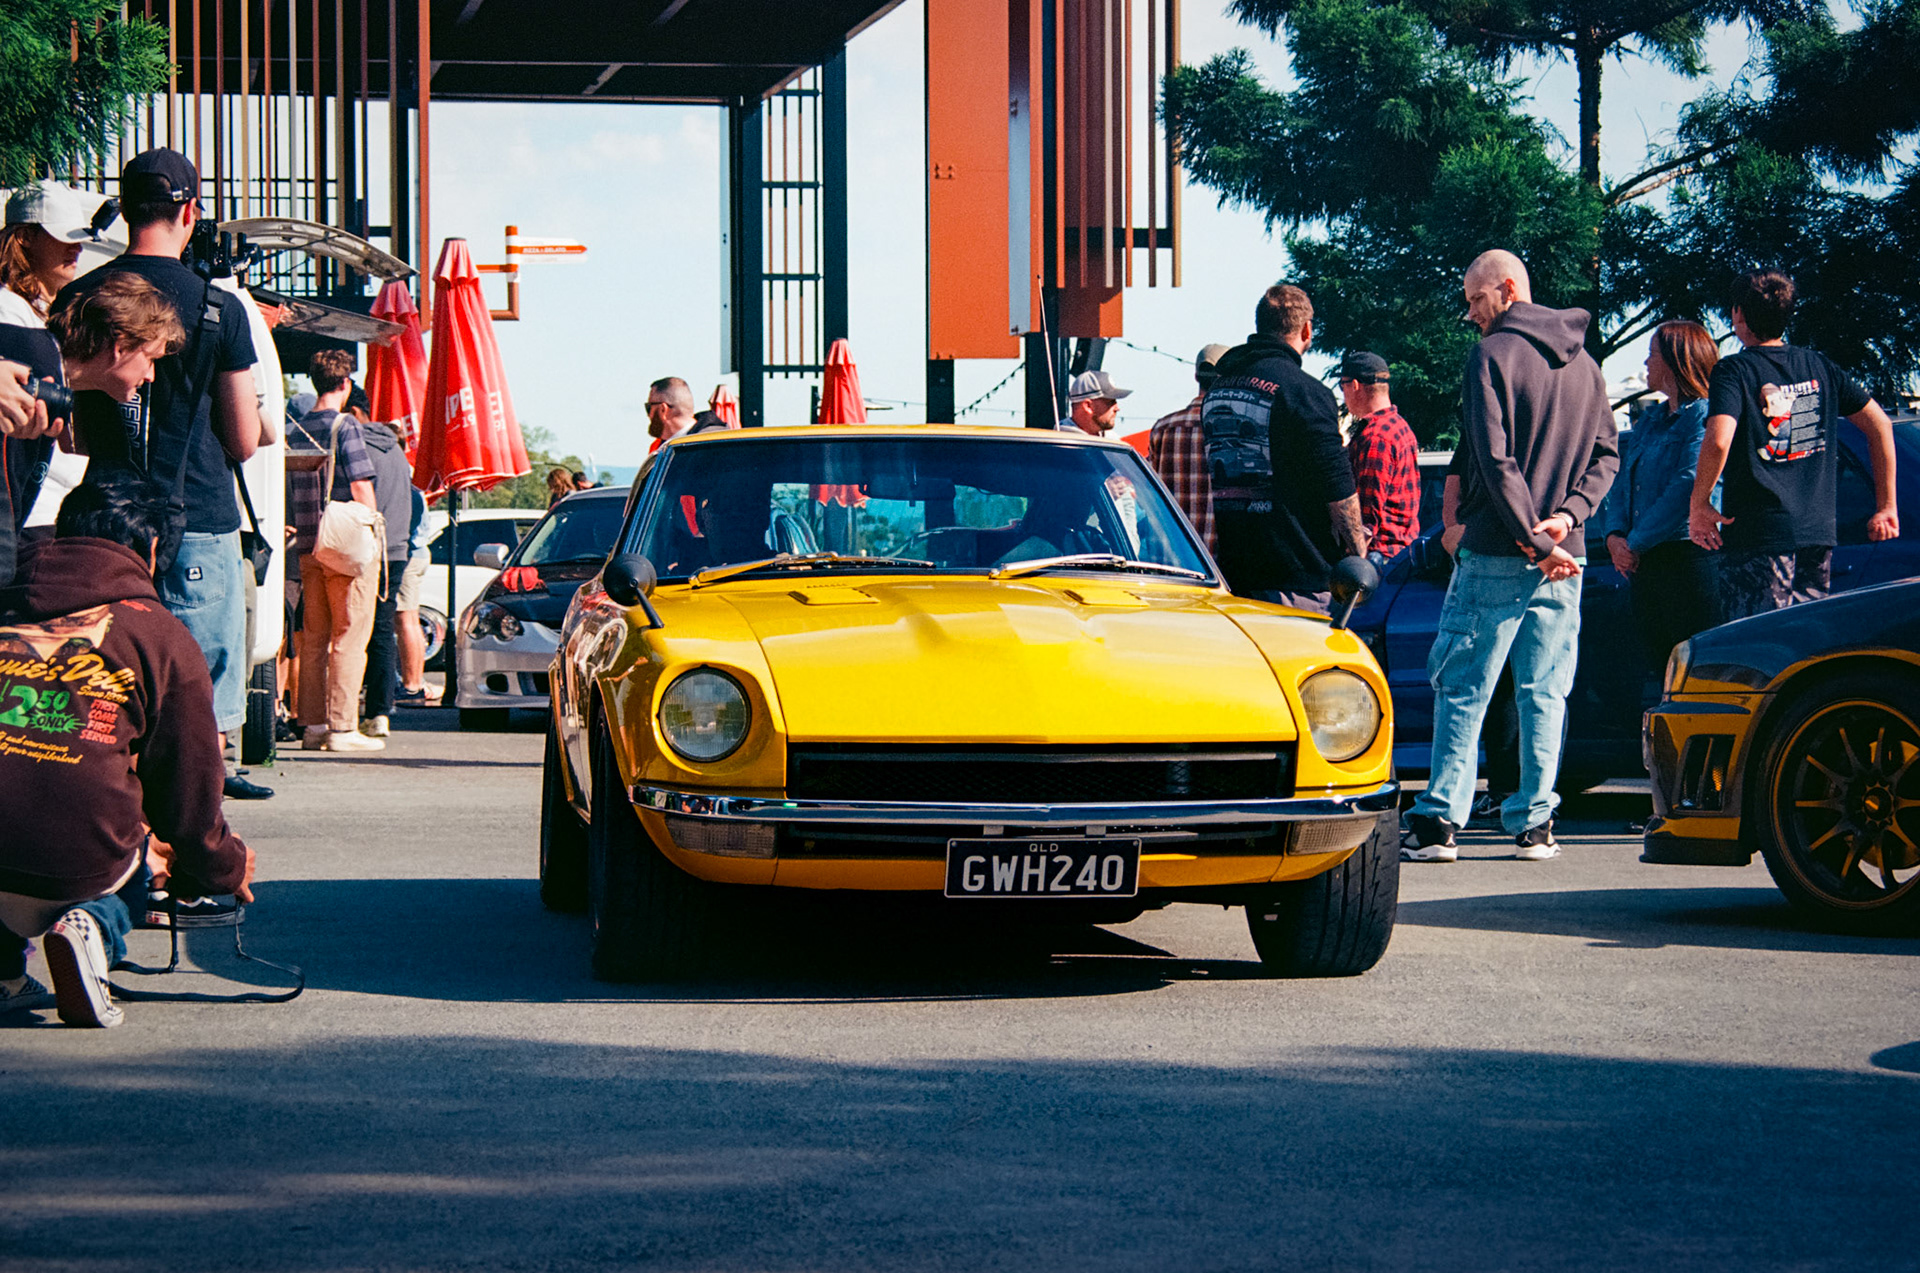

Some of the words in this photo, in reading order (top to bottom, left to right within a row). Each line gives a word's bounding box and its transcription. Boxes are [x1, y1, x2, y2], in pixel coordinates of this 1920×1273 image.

[90, 699, 120, 713] FIRST
[36, 716, 69, 728] ONLY
[88, 709, 118, 724] COME
[86, 719, 116, 734] FIRST
[79, 729, 117, 745] SERVED
[1029, 843, 1059, 853] QLD
[962, 855, 1125, 892] GWH240
